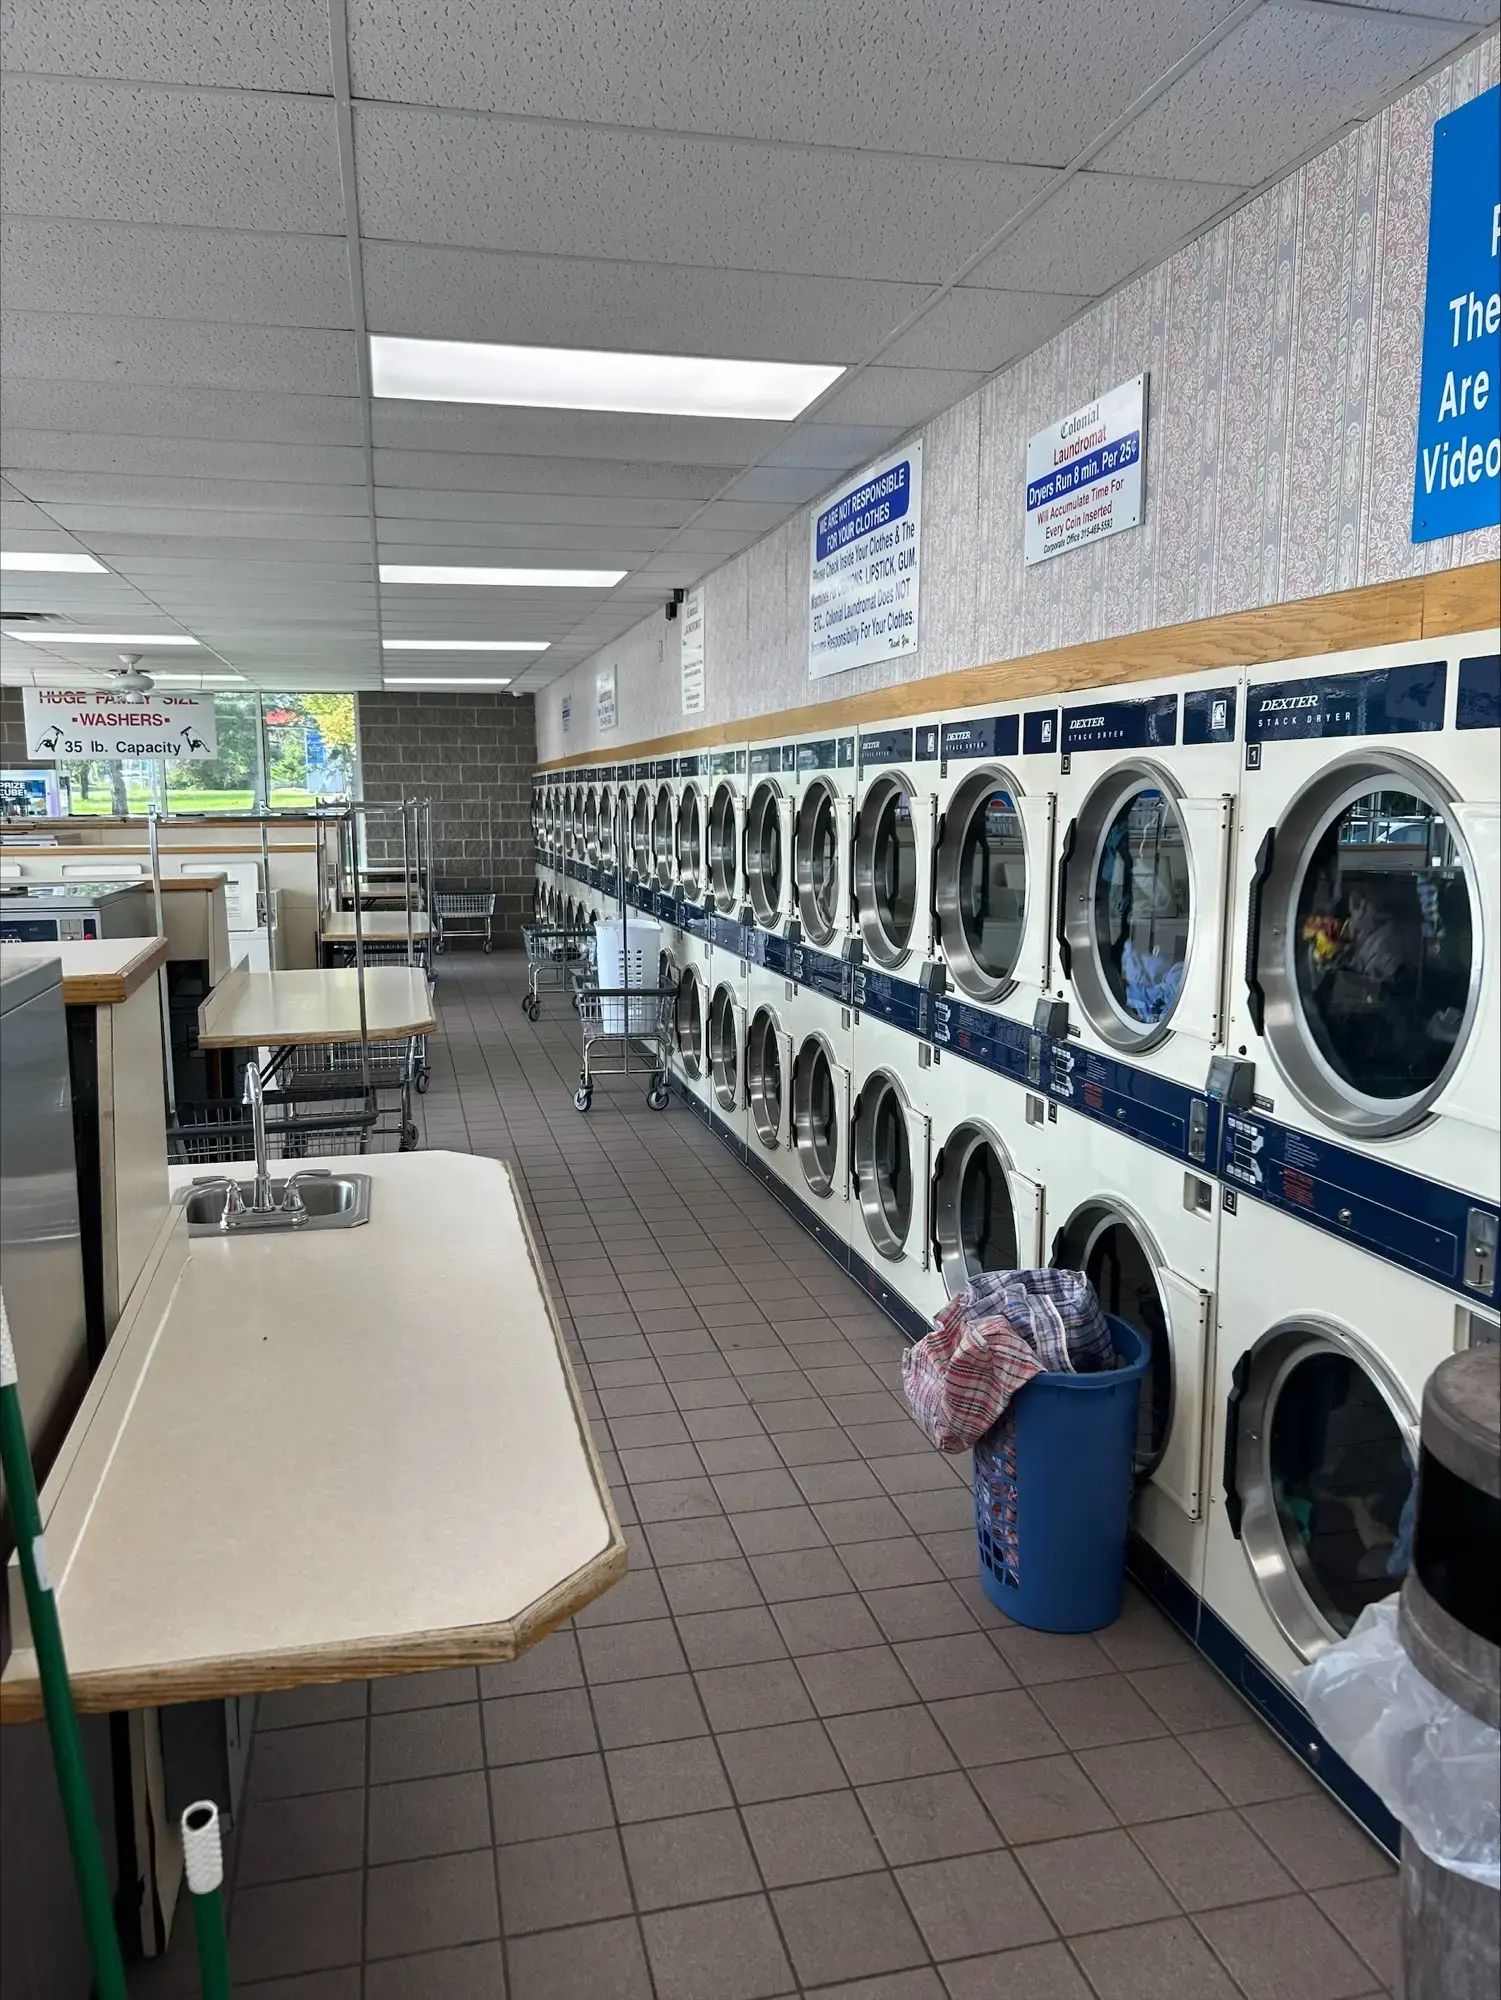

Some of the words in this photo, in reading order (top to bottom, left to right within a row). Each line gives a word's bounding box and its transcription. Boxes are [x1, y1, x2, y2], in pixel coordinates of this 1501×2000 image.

[1437, 368, 1489, 424] Are
[1060, 403, 1100, 440] Colonial
[1053, 426, 1107, 466] Laundromat
[1029, 479, 1054, 507] Dryers
[1055, 471, 1072, 492] Run
[1073, 468, 1080, 485] 8
[1081, 459, 1100, 482] min.
[1102, 450, 1118, 472] Per
[1422, 434, 1500, 496] Video
[820, 515, 828, 535] WE
[828, 507, 838, 530] ARE
[839, 498, 851, 522] NOT
[851, 467, 905, 513] RESPONSIBLE
[1037, 509, 1049, 526] Will
[1050, 493, 1090, 520] Accumulate
[1091, 485, 1109, 501] Time
[1110, 477, 1124, 493] For
[827, 532, 838, 553] FOR
[838, 521, 855, 545] YOUR
[855, 502, 890, 535] CLOTHES
[1045, 524, 1064, 540] Every
[1065, 514, 1081, 531] Coin
[1082, 500, 1113, 524] Inserted
[1066, 532, 1080, 545] Office
[855, 543, 868, 563] Your
[869, 532, 893, 556] Clothes
[894, 525, 900, 545] &
[902, 521, 915, 541] The
[865, 555, 897, 584] LIPSTICK,
[898, 547, 917, 572] GUM,
[844, 592, 876, 620] Laundromat
[878, 588, 894, 607] Does
[895, 577, 911, 601] NOT
[861, 621, 870, 640] For
[871, 618, 886, 636] Your
[888, 608, 914, 631] Clothes.
[39, 691, 87, 704] HUGE
[1259, 695, 1319, 712] DEXTER
[80, 713, 163, 726] WASHERS
[946, 731, 971, 742] DEXTER
[1068, 732, 1093, 742] STACK
[1069, 716, 1105, 730] DEXTER
[1258, 717, 1297, 728] STACK
[1307, 711, 1352, 724] DRYER
[64, 741, 83, 753] 35
[91, 741, 108, 753] lb.
[116, 741, 181, 756] Capacity
